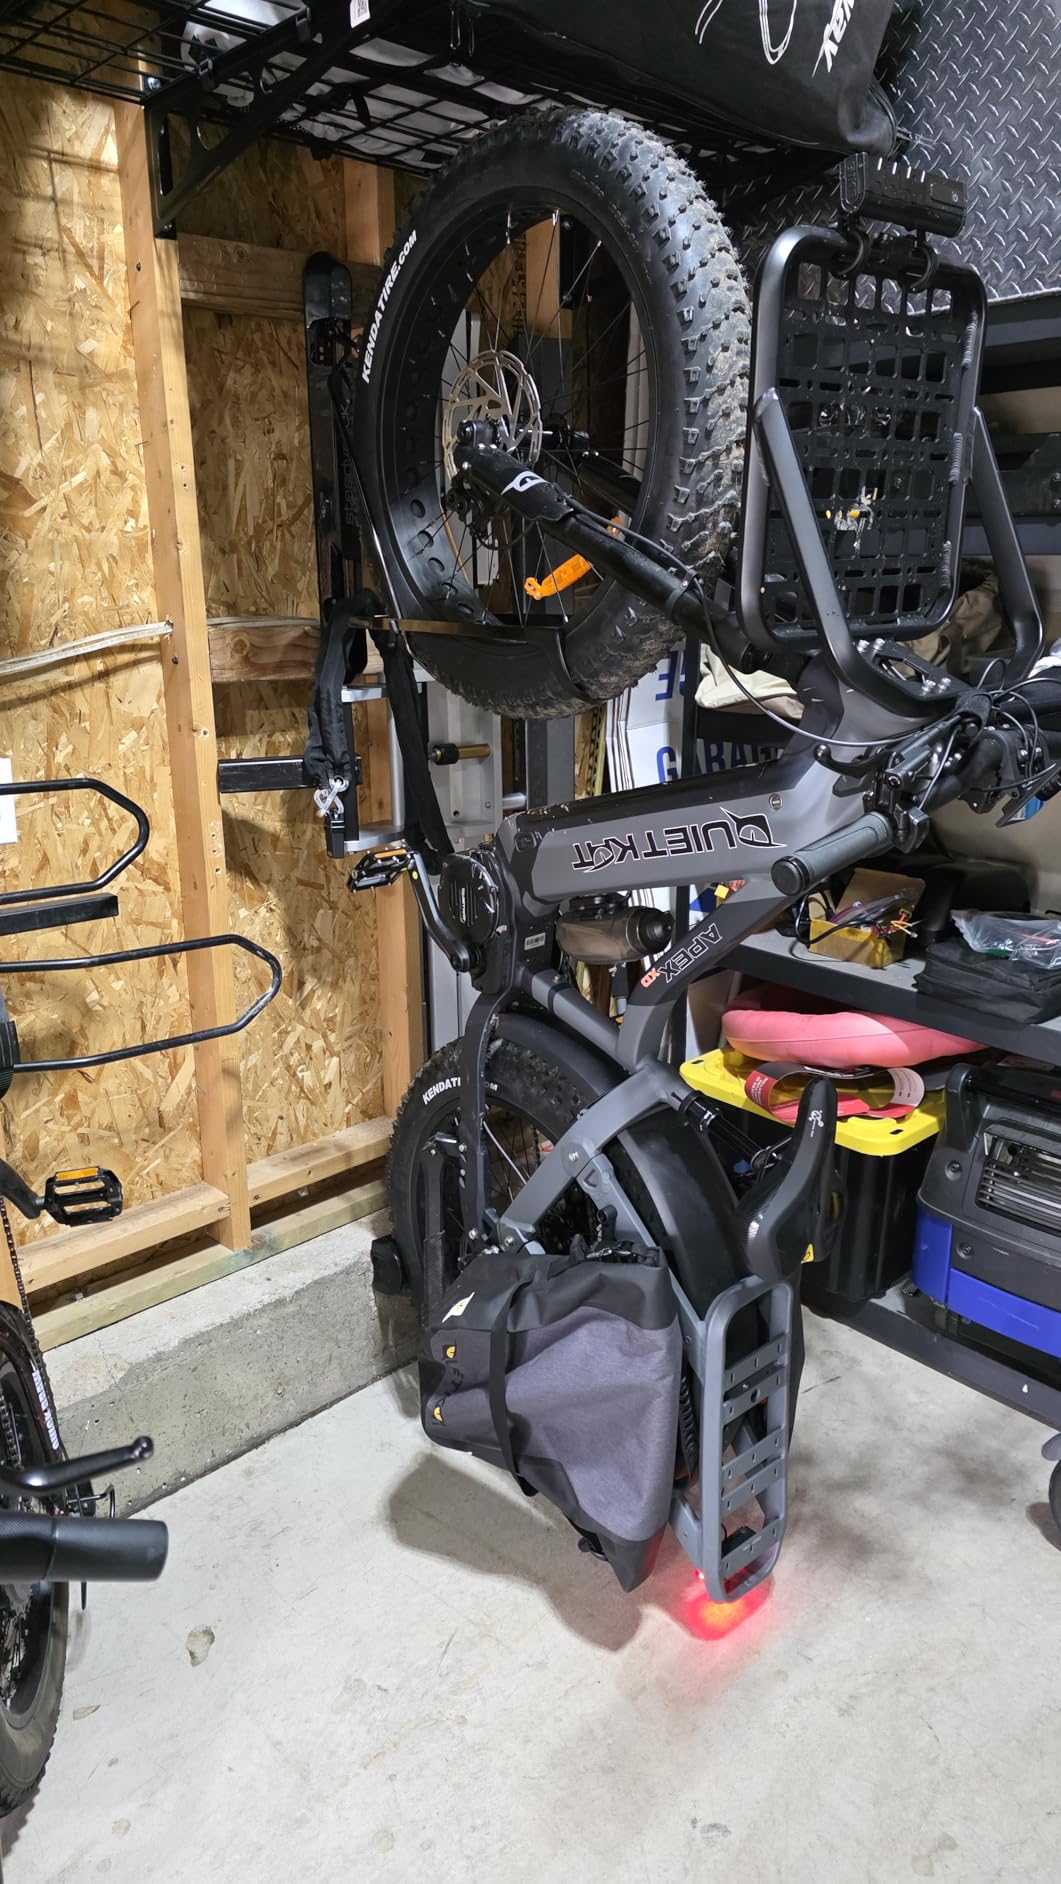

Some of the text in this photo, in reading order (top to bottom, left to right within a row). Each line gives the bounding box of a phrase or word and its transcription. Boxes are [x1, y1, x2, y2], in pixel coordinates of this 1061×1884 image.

[361, 230, 417, 383] KENDATIRE.COM
[571, 807, 787, 874] QUIETKAT
[657, 922, 723, 984] APEX
